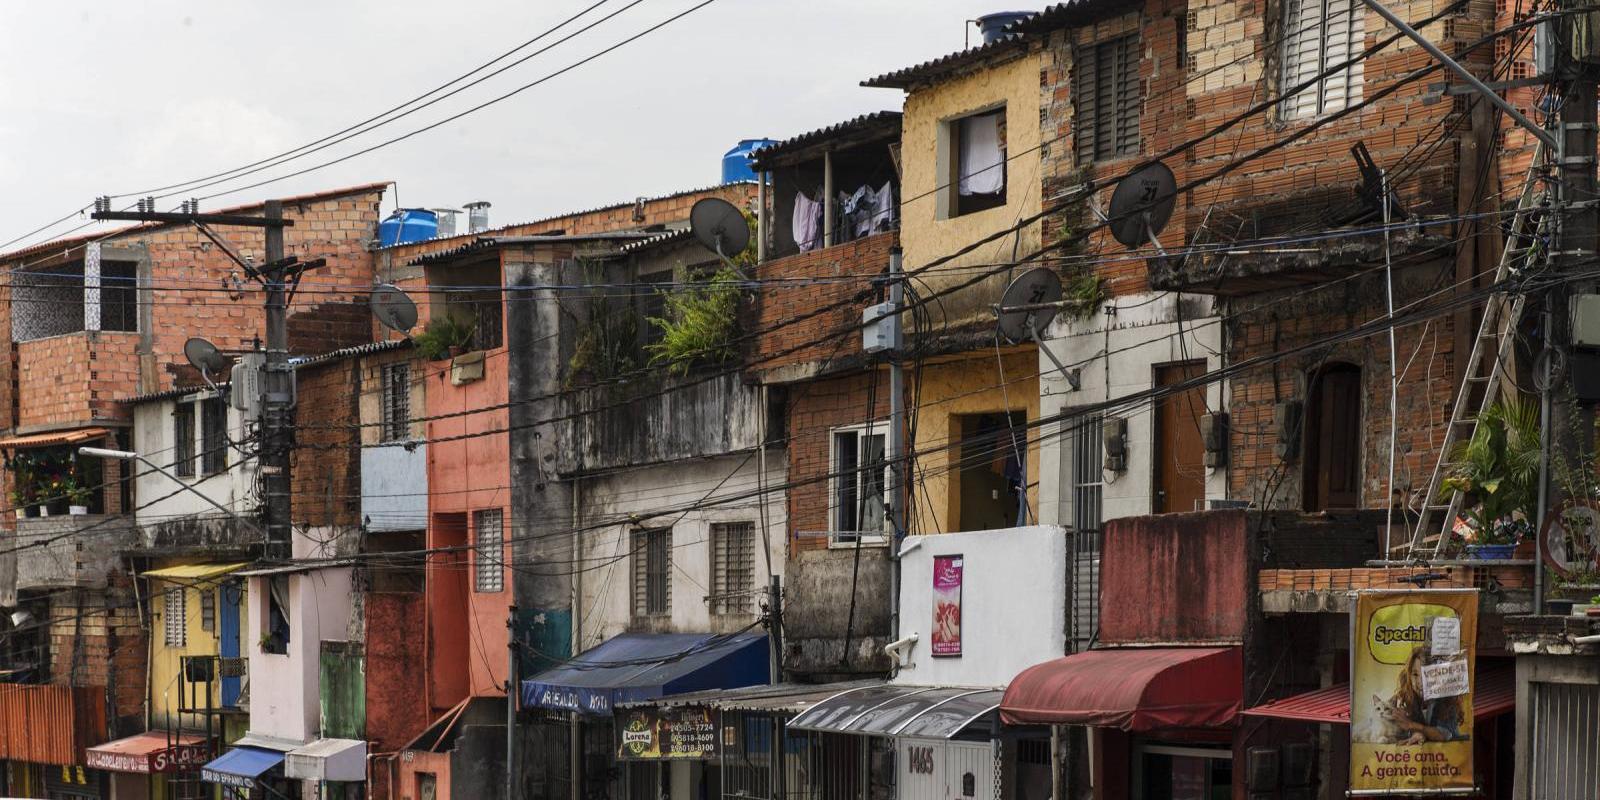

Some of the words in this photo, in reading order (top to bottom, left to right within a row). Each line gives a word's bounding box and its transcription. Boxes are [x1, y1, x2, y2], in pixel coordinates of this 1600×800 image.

[1375, 625, 1426, 645] Special
[626, 732, 650, 741] Lorena
[908, 746, 933, 775] 1465
[1375, 750, 1410, 762] Você
[1414, 752, 1448, 762] ama.
[1361, 765, 1373, 777] A
[1376, 765, 1417, 780] gente
[1421, 763, 1461, 777] cuida.
